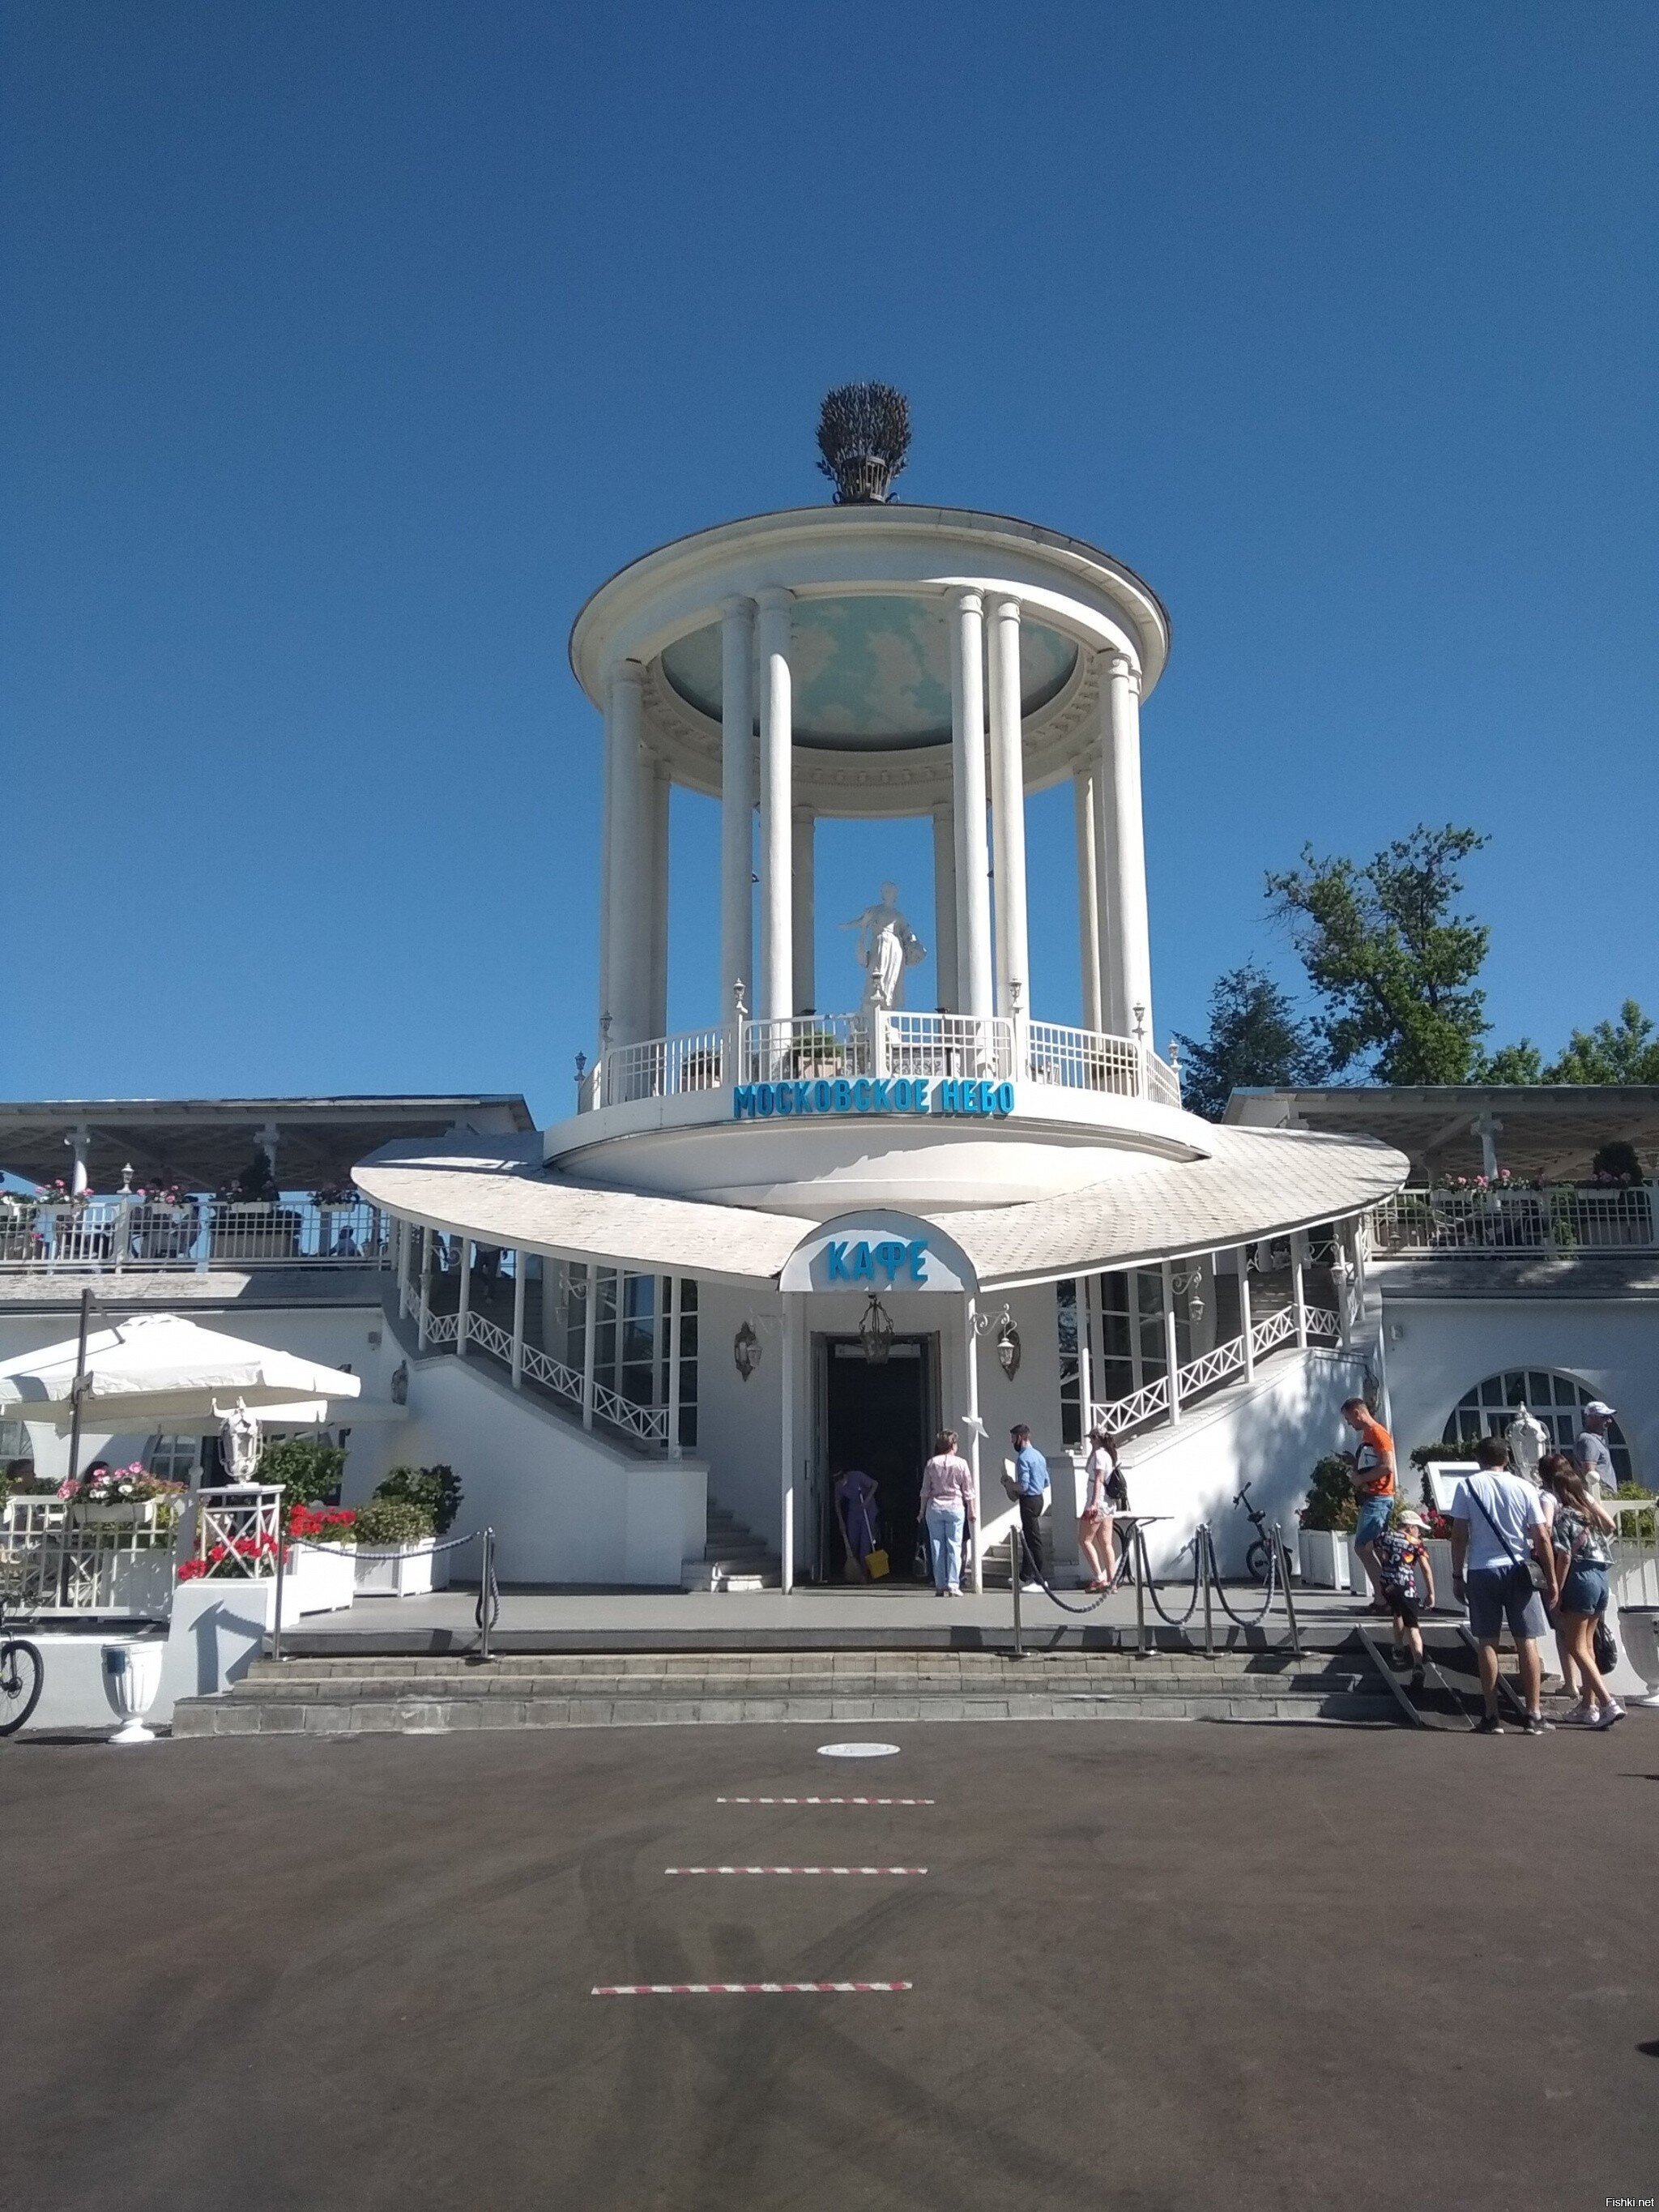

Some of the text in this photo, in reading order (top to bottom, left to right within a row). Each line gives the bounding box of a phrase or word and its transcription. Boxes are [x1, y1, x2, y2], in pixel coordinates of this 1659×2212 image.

[733, 1078, 1015, 1119] МОСКОВСКОЕ НЕБО
[827, 1241, 929, 1282] КАФЕ
